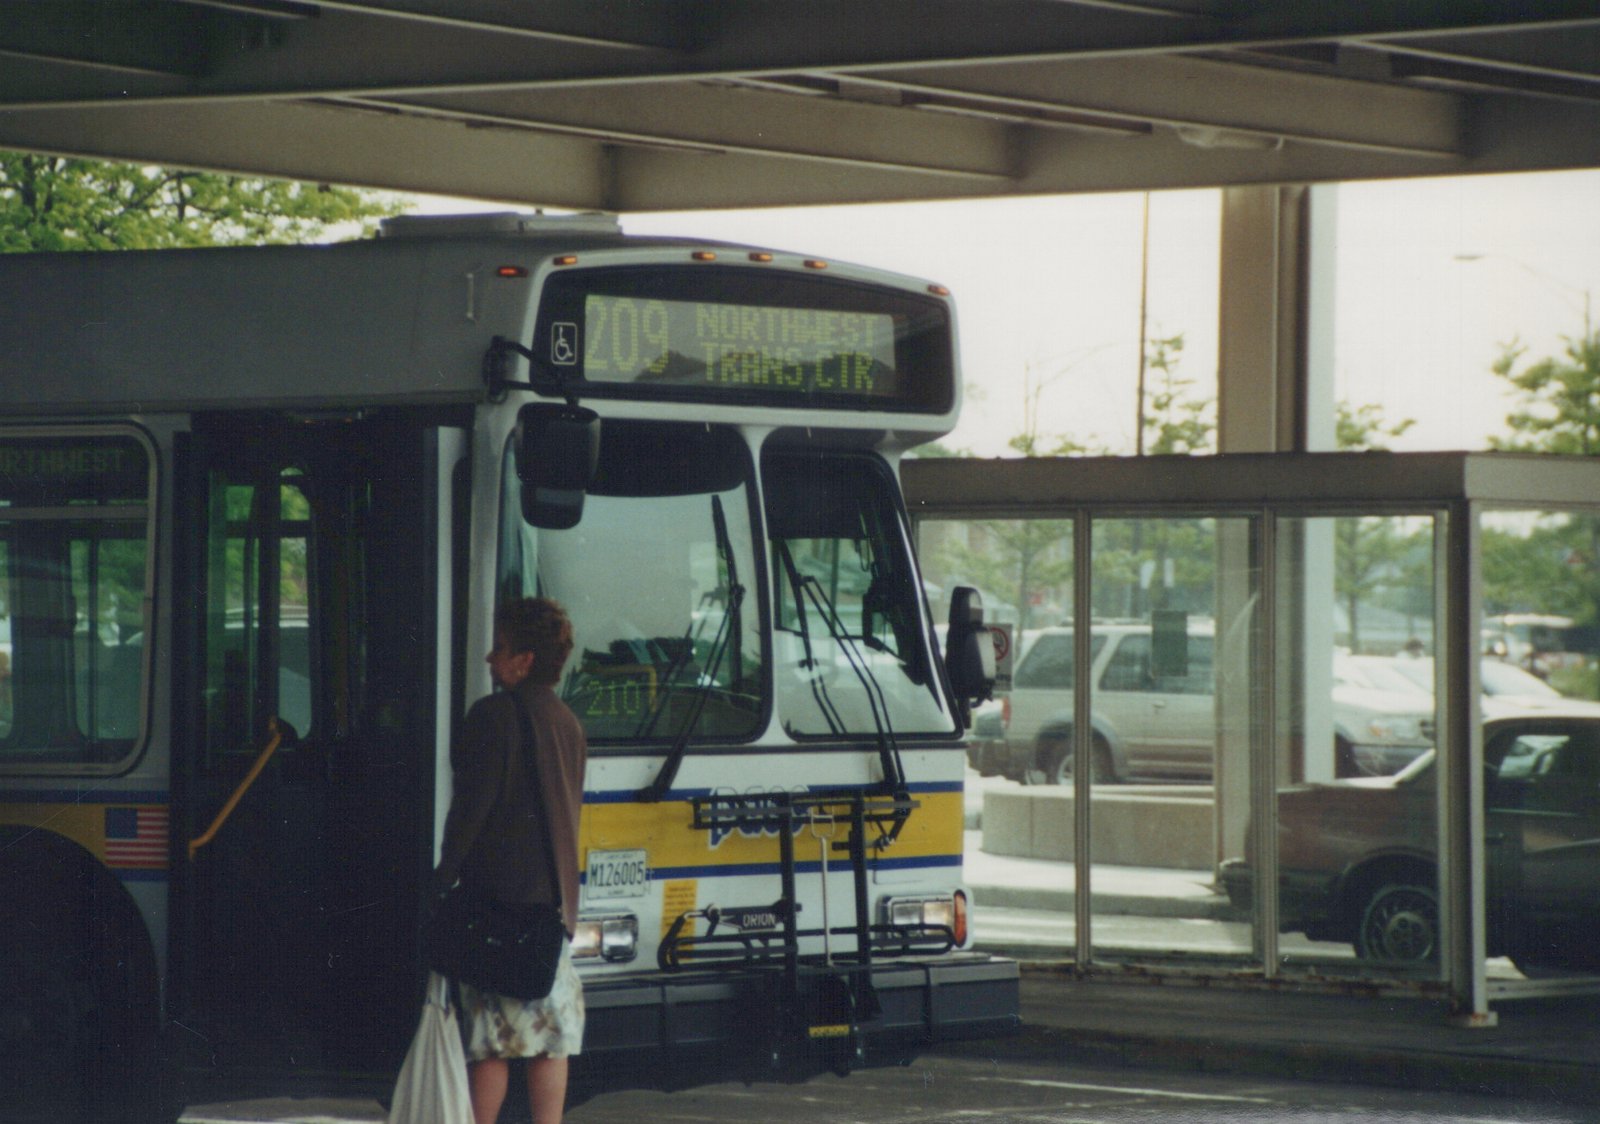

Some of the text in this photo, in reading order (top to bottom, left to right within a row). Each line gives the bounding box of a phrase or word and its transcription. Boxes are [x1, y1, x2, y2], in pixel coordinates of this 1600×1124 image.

[586, 297, 669, 374] 209
[696, 304, 878, 346] NORTHWEST
[816, 350, 874, 390] CTR
[586, 679, 640, 715] 210
[590, 861, 645, 888] M126005
[742, 913, 776, 927] ORION
